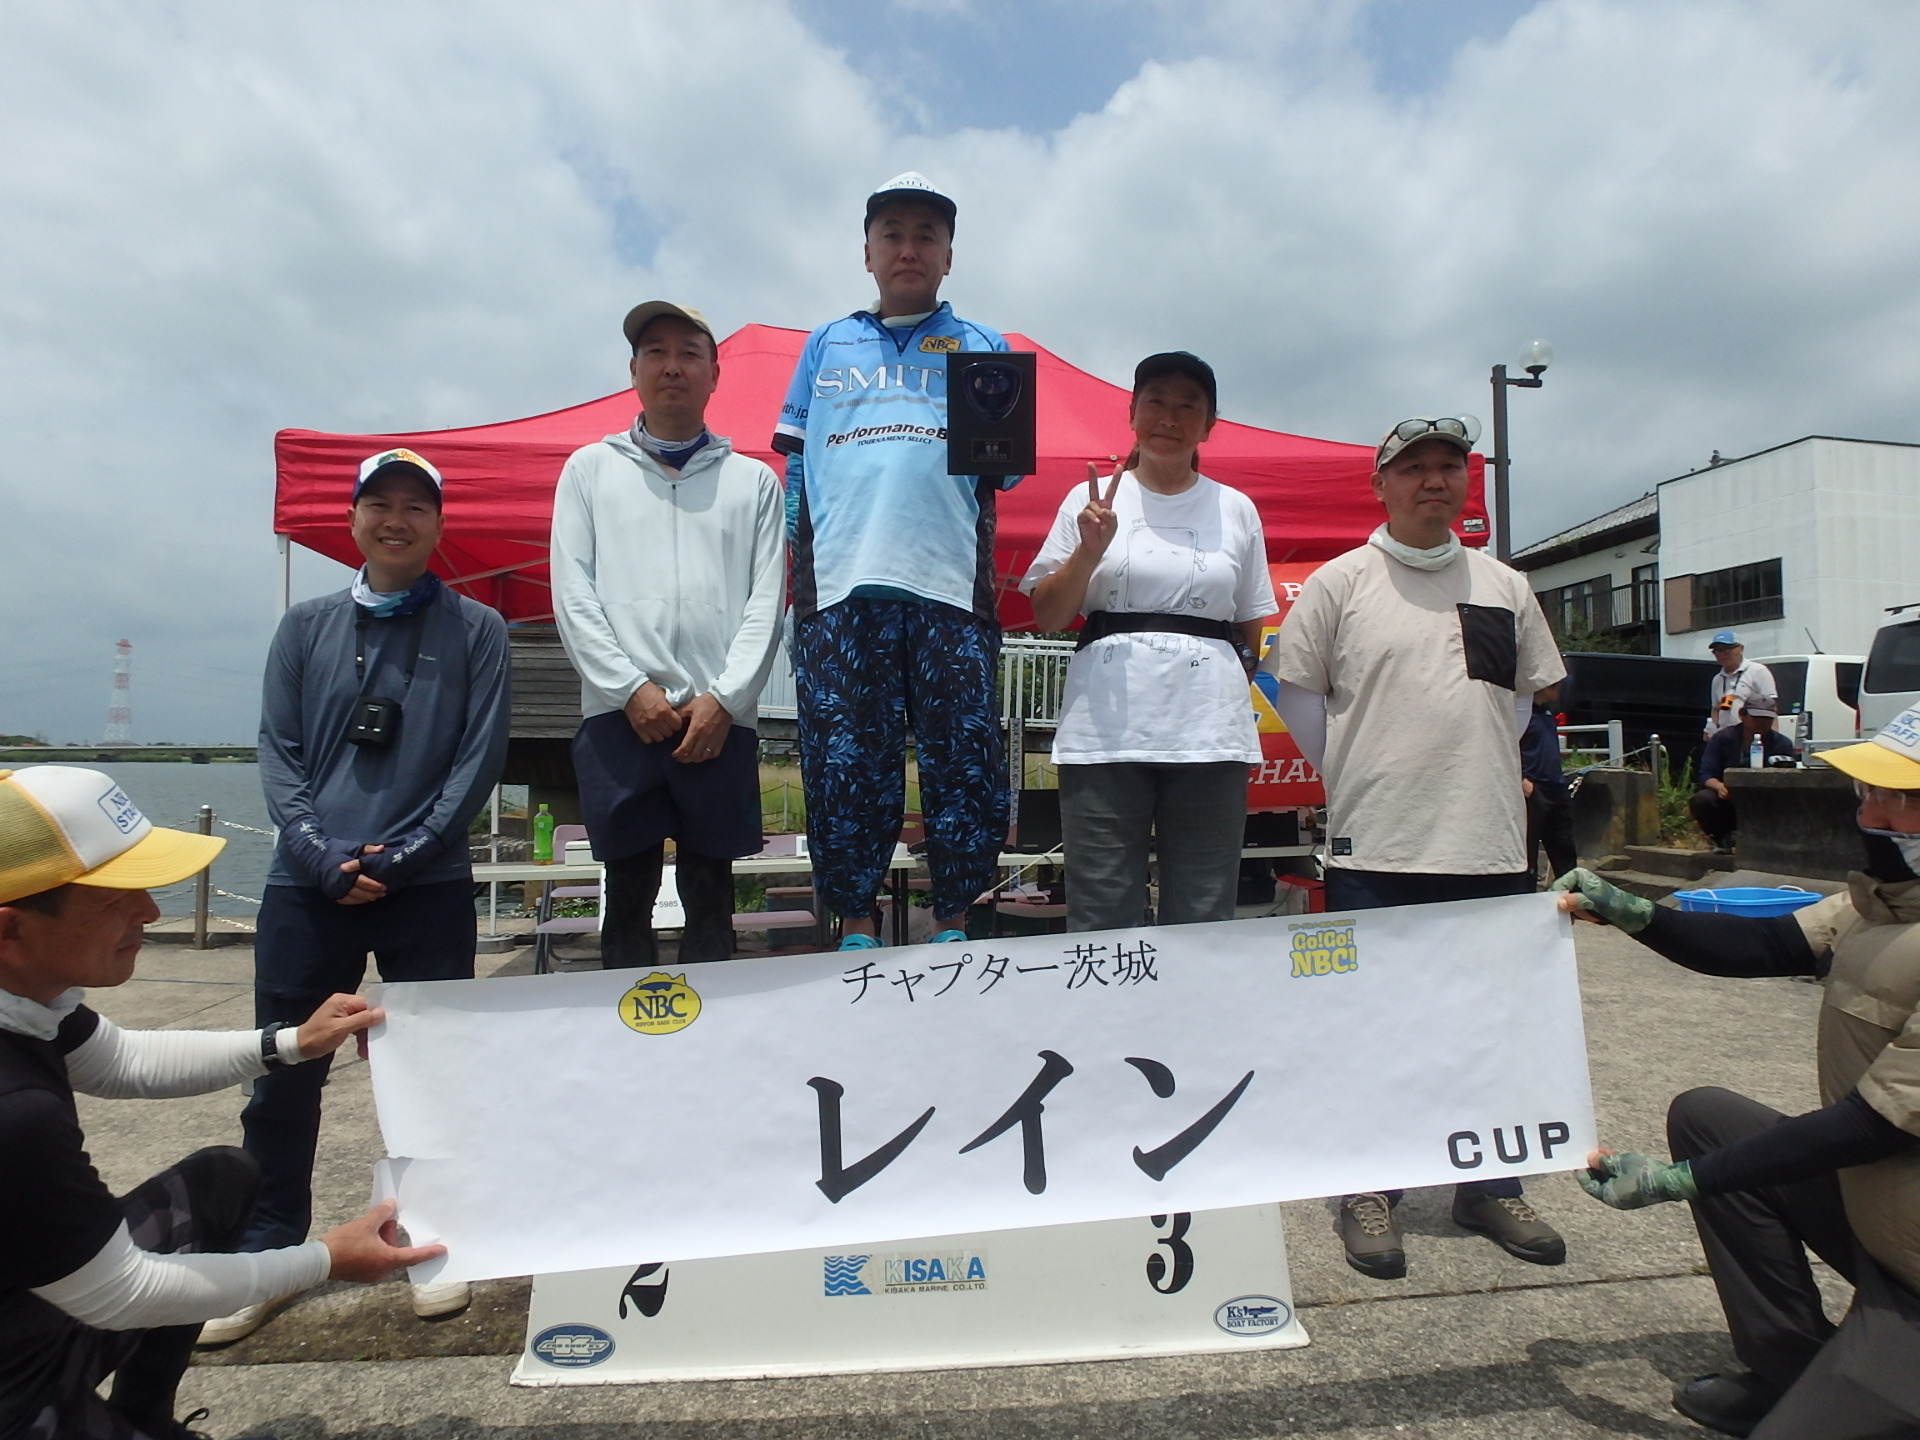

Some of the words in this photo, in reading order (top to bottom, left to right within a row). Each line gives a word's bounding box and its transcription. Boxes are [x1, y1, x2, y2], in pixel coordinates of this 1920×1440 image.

[814, 363, 947, 399] SMIT
[857, 435, 906, 447] TOURNAMENT
[908, 435, 932, 445] SELECT
[841, 939, 1159, 1005] チャプター茨城
[1289, 945, 1359, 978] NBC!
[632, 992, 688, 1021] NBC
[806, 1049, 1255, 1205] レイン
[1447, 1121, 1570, 1170] CUP
[1146, 1211, 1194, 1294] 3
[884, 1256, 987, 1284] KISAKA
[884, 1286, 916, 1294] KISAKA
[918, 1284, 949, 1293] MARINE
[1227, 1319, 1246, 1328] BOAT
[1248, 1317, 1279, 1327] FACTORY
